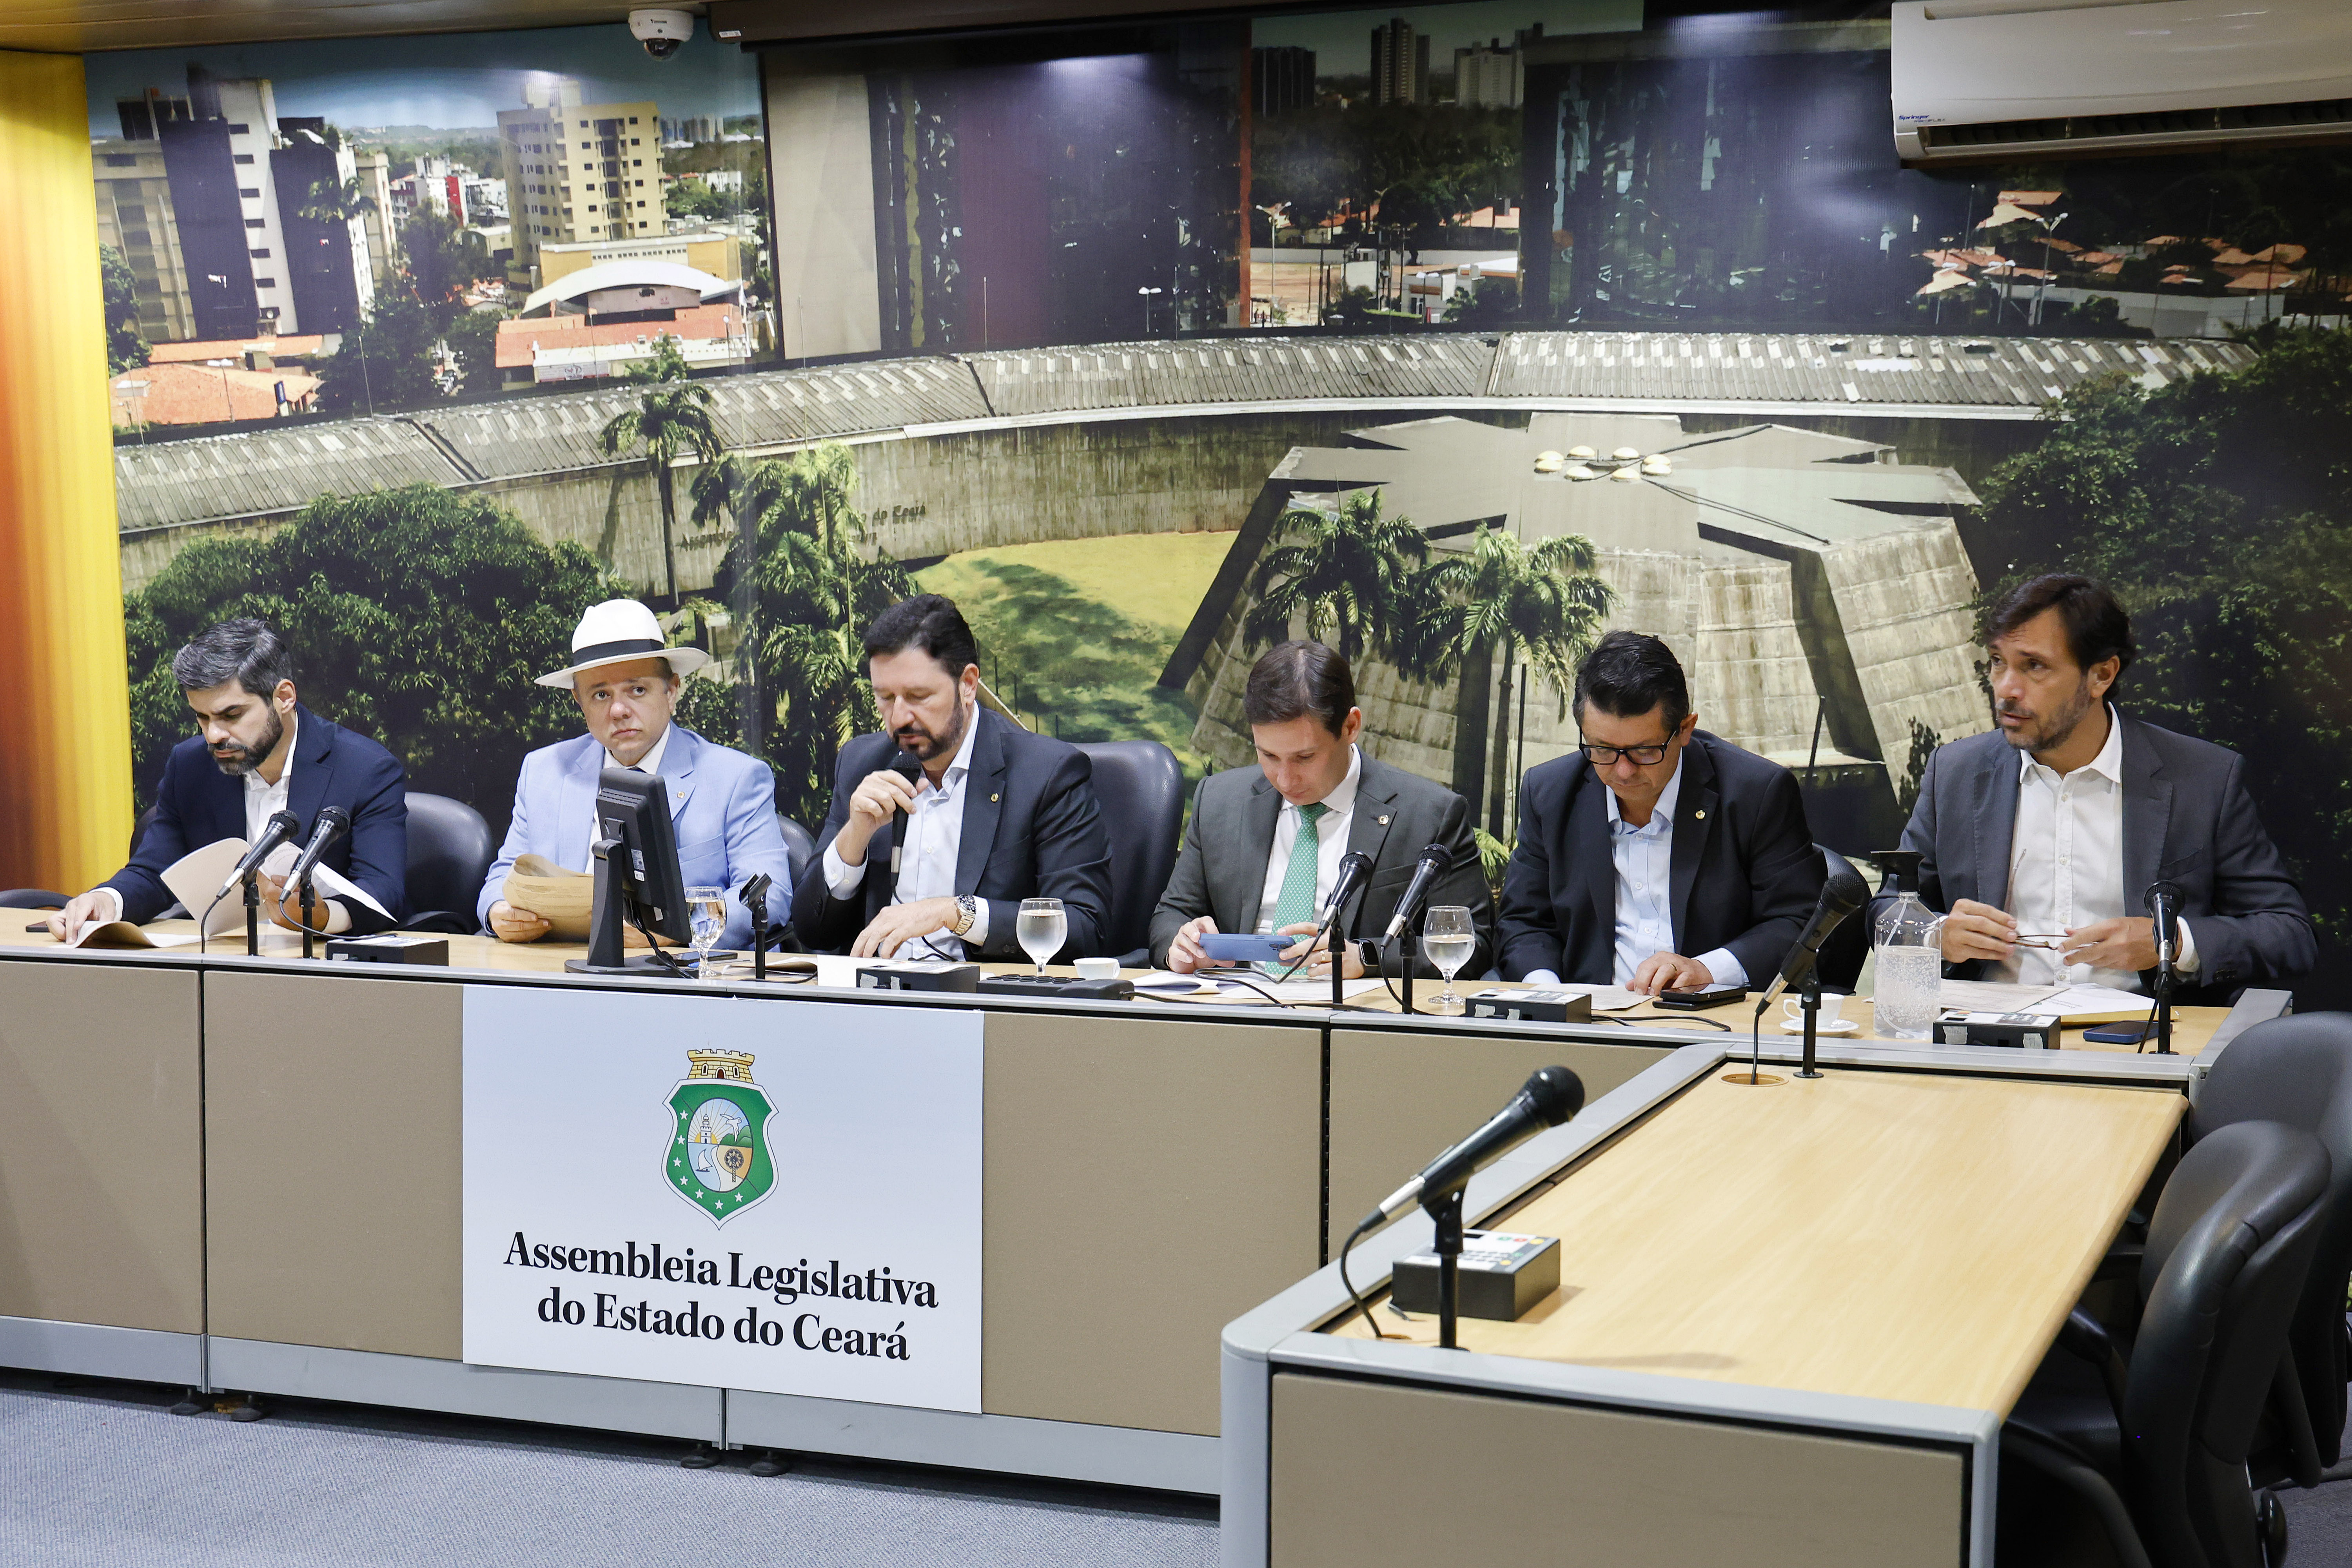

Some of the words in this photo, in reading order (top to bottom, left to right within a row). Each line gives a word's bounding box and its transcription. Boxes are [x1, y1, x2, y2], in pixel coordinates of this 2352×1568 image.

[680, 528, 735, 550] Assemble
[503, 1232, 721, 1286] Assembleia
[727, 1252, 939, 1308] Legislativa
[538, 1287, 585, 1325] do
[593, 1293, 724, 1340] Estado
[734, 1307, 783, 1346] do
[793, 1314, 910, 1361] Ceará
